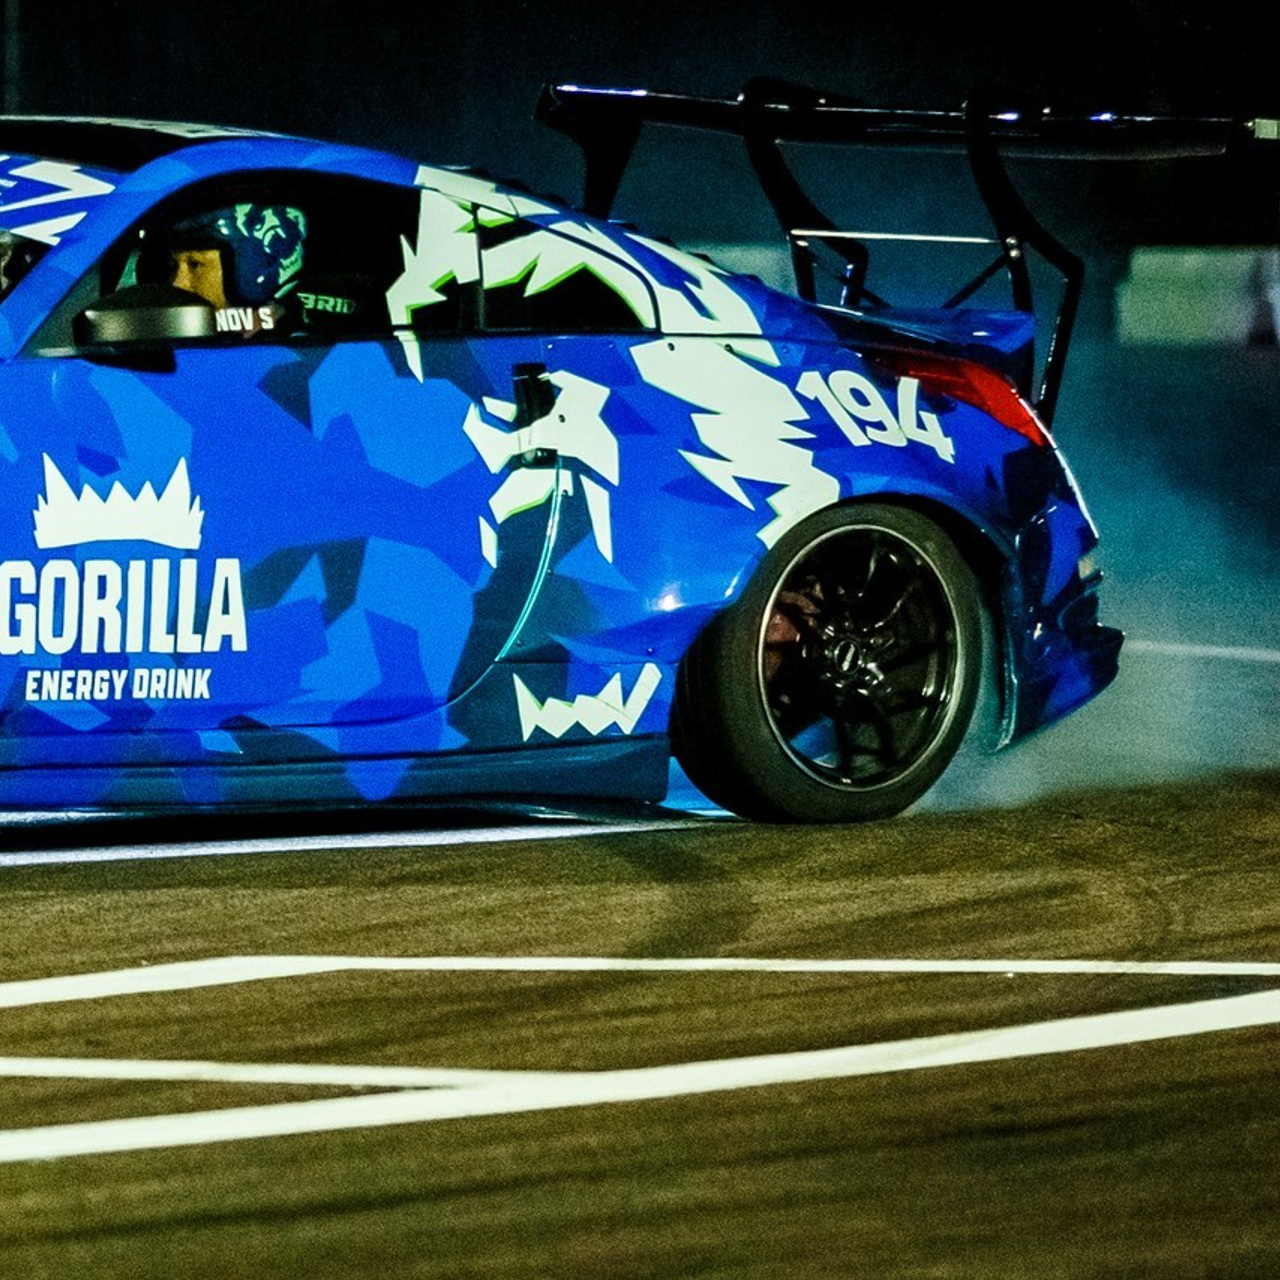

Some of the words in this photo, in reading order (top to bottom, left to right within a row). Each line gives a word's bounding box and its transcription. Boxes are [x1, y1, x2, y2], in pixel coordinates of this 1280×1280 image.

[258, 307, 275, 330] S
[795, 370, 955, 464] 194
[25, 669, 129, 701] ENERGY
[132, 668, 213, 700] DRINK
